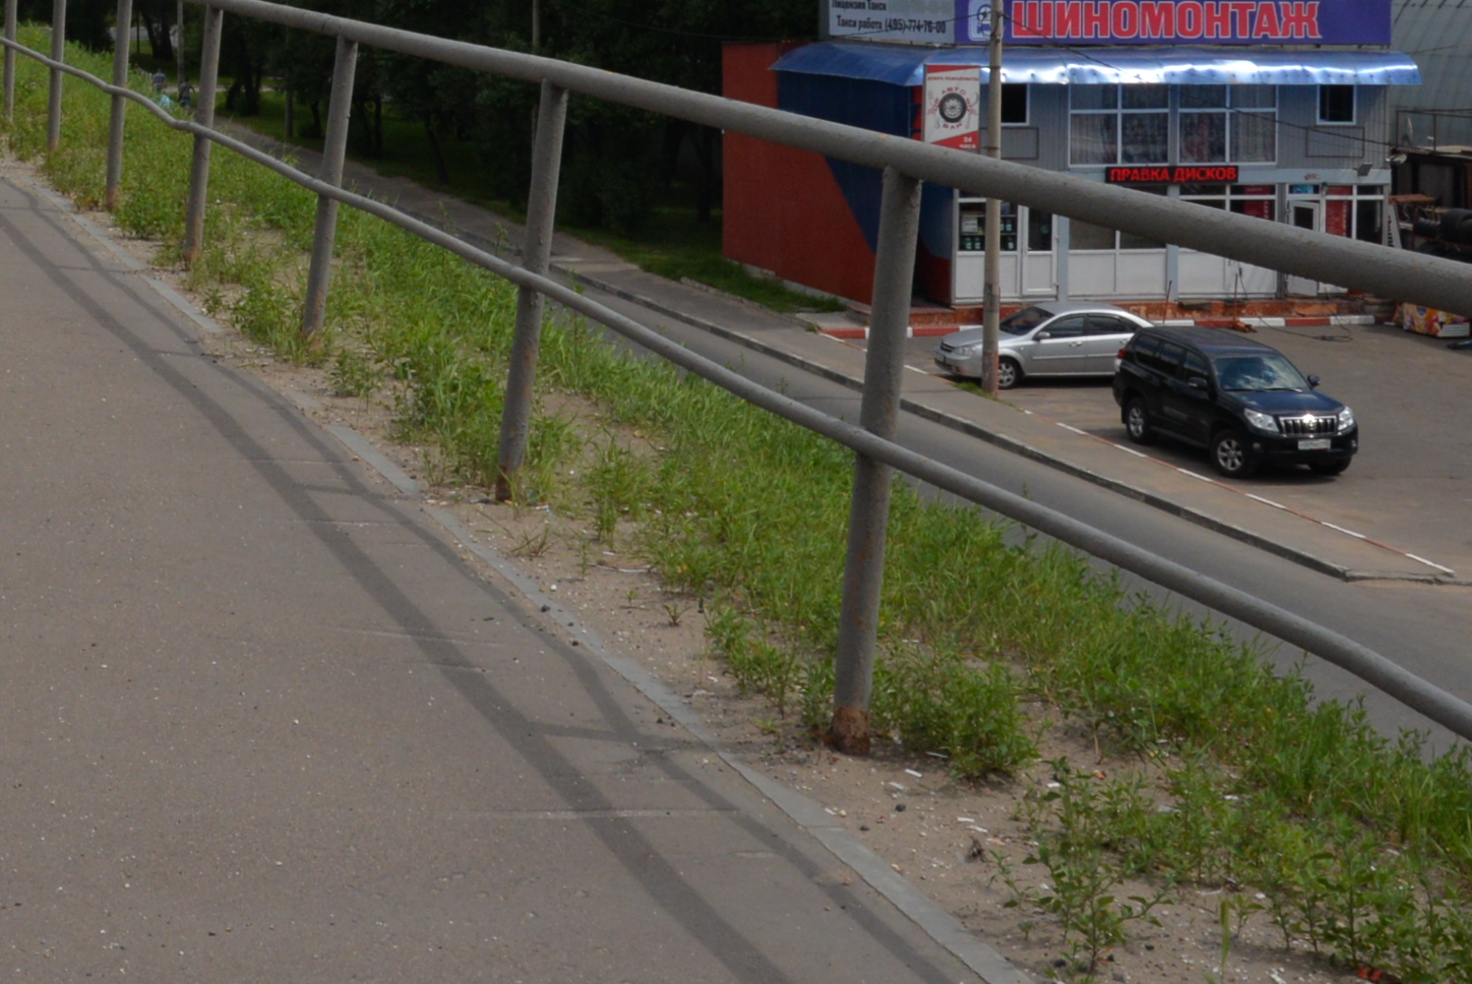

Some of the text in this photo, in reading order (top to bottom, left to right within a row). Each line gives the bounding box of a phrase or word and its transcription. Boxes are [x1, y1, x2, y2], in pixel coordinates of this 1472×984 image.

[858, 17, 882, 31] работа
[1011, 0, 1322, 39] ШИНОМОНТАЖ
[1109, 166, 1237, 183] ПРАВКА ДИСКОВ
